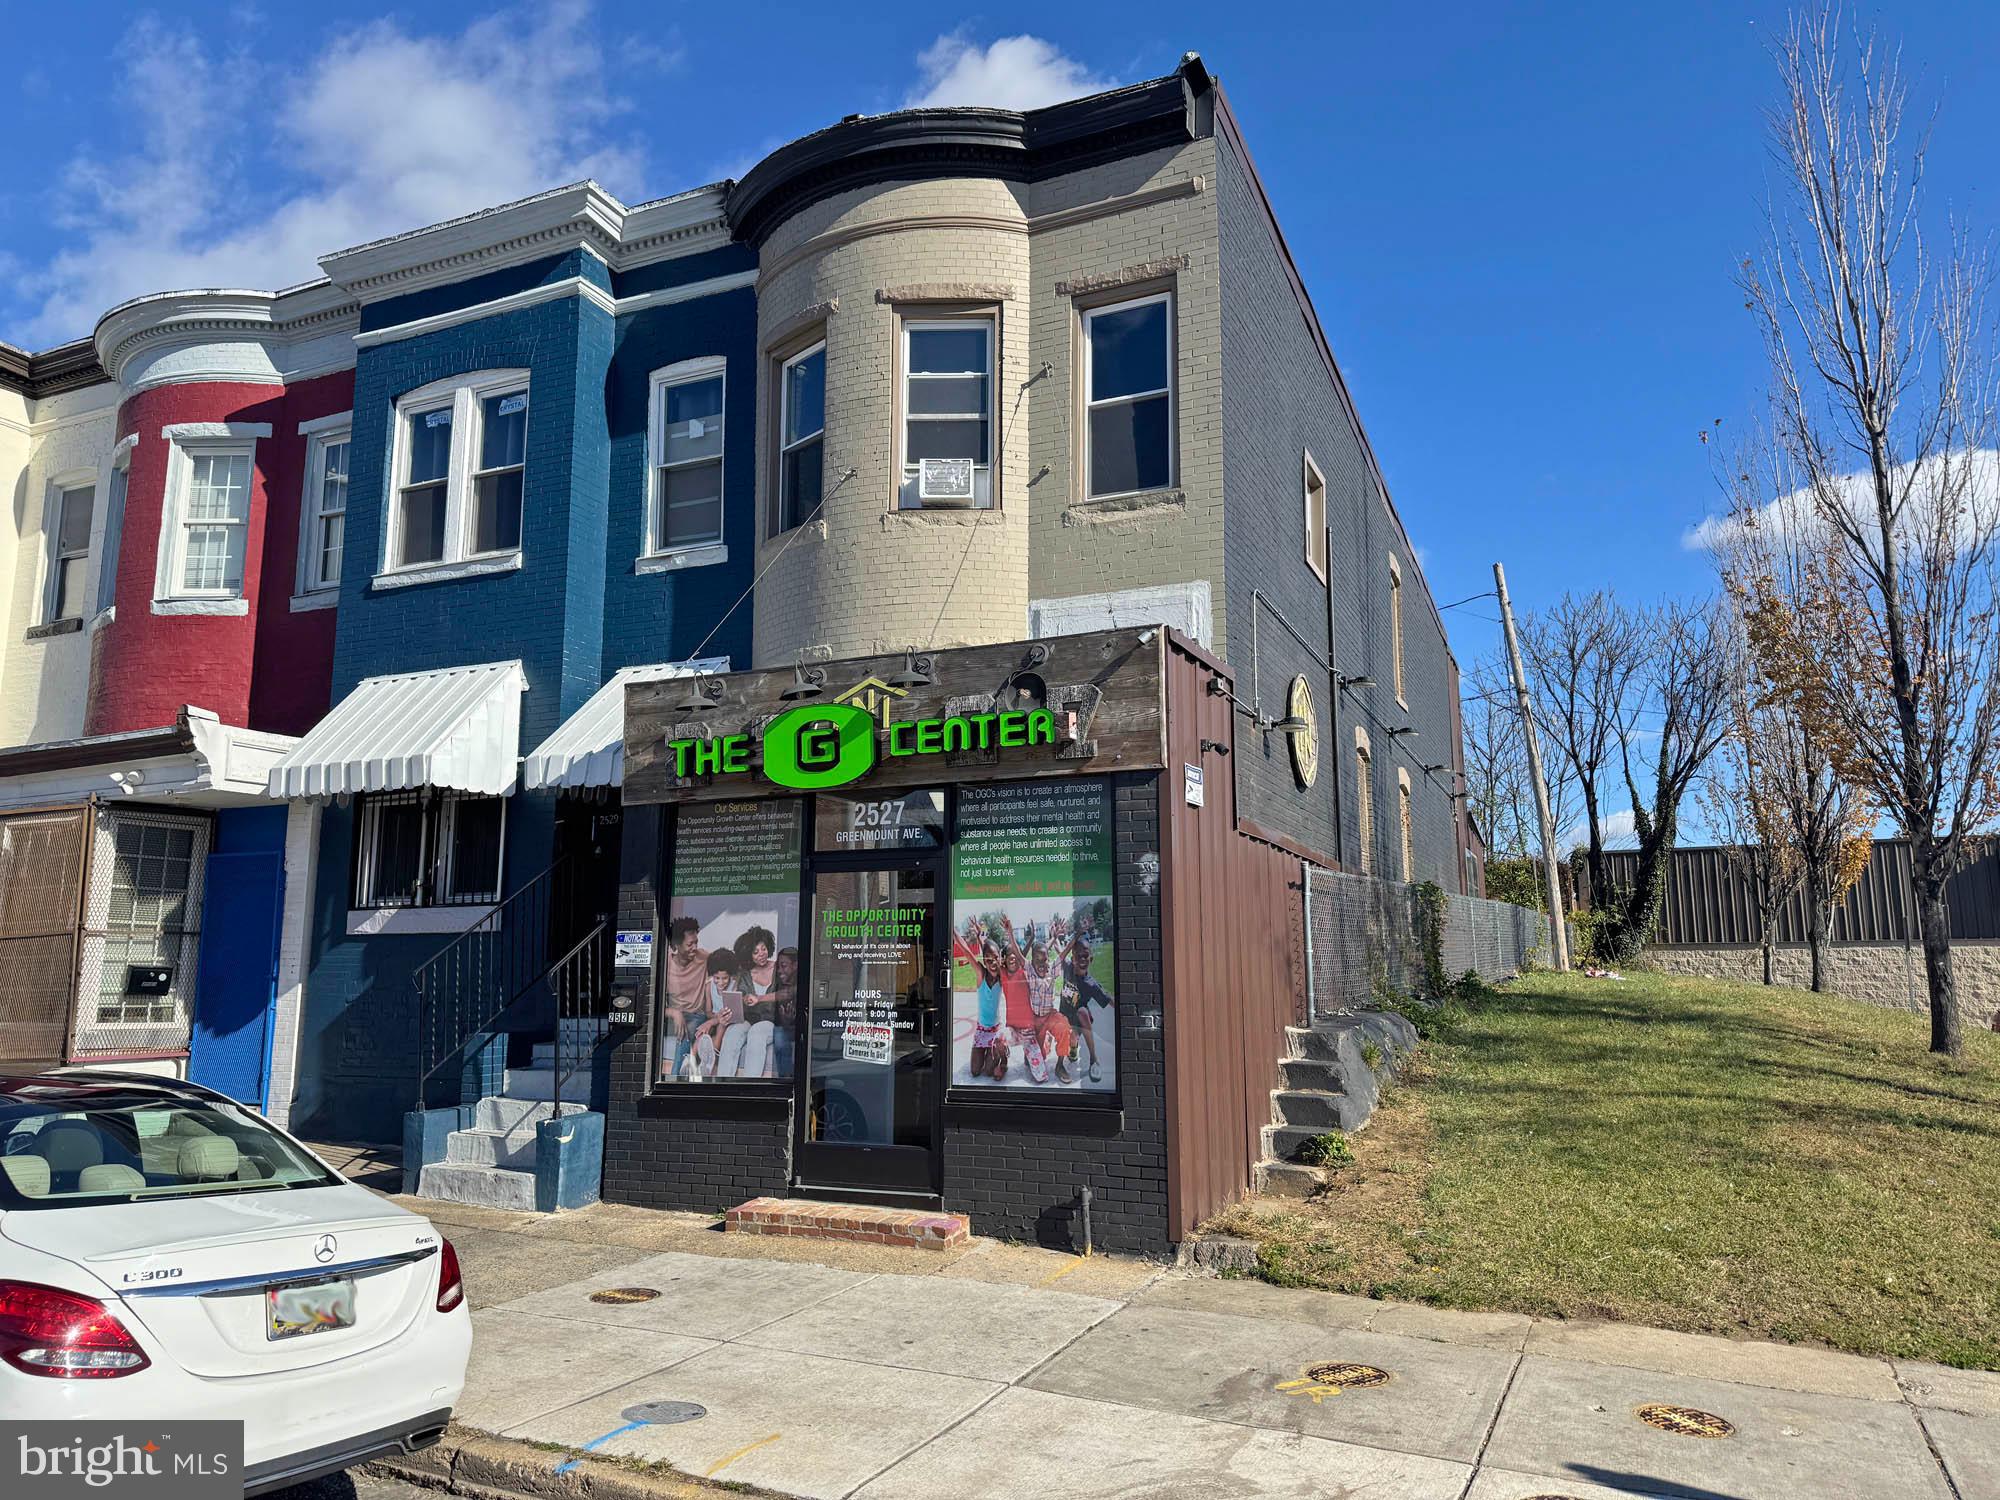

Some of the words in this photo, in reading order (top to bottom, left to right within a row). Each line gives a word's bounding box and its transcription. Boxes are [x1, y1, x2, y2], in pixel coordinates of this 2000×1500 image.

[668, 733, 749, 778] THE
[890, 707, 1055, 757] CENTER
[961, 789, 973, 799] The
[975, 788, 996, 798] OGC's
[998, 788, 1016, 797] vision
[1017, 787, 1022, 796] is
[1024, 786, 1030, 795] to
[1032, 785, 1051, 795] create
[1054, 785, 1063, 793] an
[1064, 783, 1102, 794] atmosphere
[715, 803, 727, 813] Our
[729, 802, 758, 813] Services
[960, 803, 979, 812] where
[990, 800, 1025, 811] participants
[1027, 799, 1038, 809] feel
[1087, 795, 1101, 805] and
[854, 801, 905, 826] 2527
[960, 815, 990, 826] motivated
[992, 816, 998, 824] to
[1000, 814, 1024, 824] address
[1026, 813, 1040, 823] their
[1042, 811, 1064, 822] mental
[1065, 811, 1085, 820] health
[1087, 810, 1100, 819] and
[836, 828, 900, 842] GREENMOUNT
[903, 827, 923, 839] AVE.
[960, 828, 991, 839] substance
[994, 828, 1005, 837] use
[1030, 826, 1036, 835] to
[1038, 825, 1058, 835] create
[1066, 823, 1101, 834] community
[960, 841, 979, 851] where
[990, 840, 1011, 852] people
[1013, 838, 1028, 849] have
[1030, 837, 1057, 848] unlimited
[1059, 837, 1083, 847] access
[1085, 837, 1091, 845] to
[960, 855, 991, 866] behavioral
[993, 854, 1011, 863] health
[1013, 853, 1044, 863] resources
[1045, 852, 1070, 862] needed
[1073, 852, 1079, 860] to
[960, 869, 971, 878] not
[971, 868, 982, 879] just
[985, 868, 991, 876] to
[822, 910, 843, 922] THE
[846, 909, 926, 921] OPPORTUNITY
[826, 925, 873, 938] GROWTH
[877, 924, 921, 937] CENTER
[855, 990, 881, 999] HOURS
[874, 1000, 893, 1009] Friday
[609, 1013, 634, 1022] 2527
[838, 1010, 863, 1018] 9:00am
[888, 1011, 898, 1019] pm
[891, 1021, 914, 1029] Sunday
[123, 1273, 137, 1283] C
[141, 1267, 182, 1281] 300
